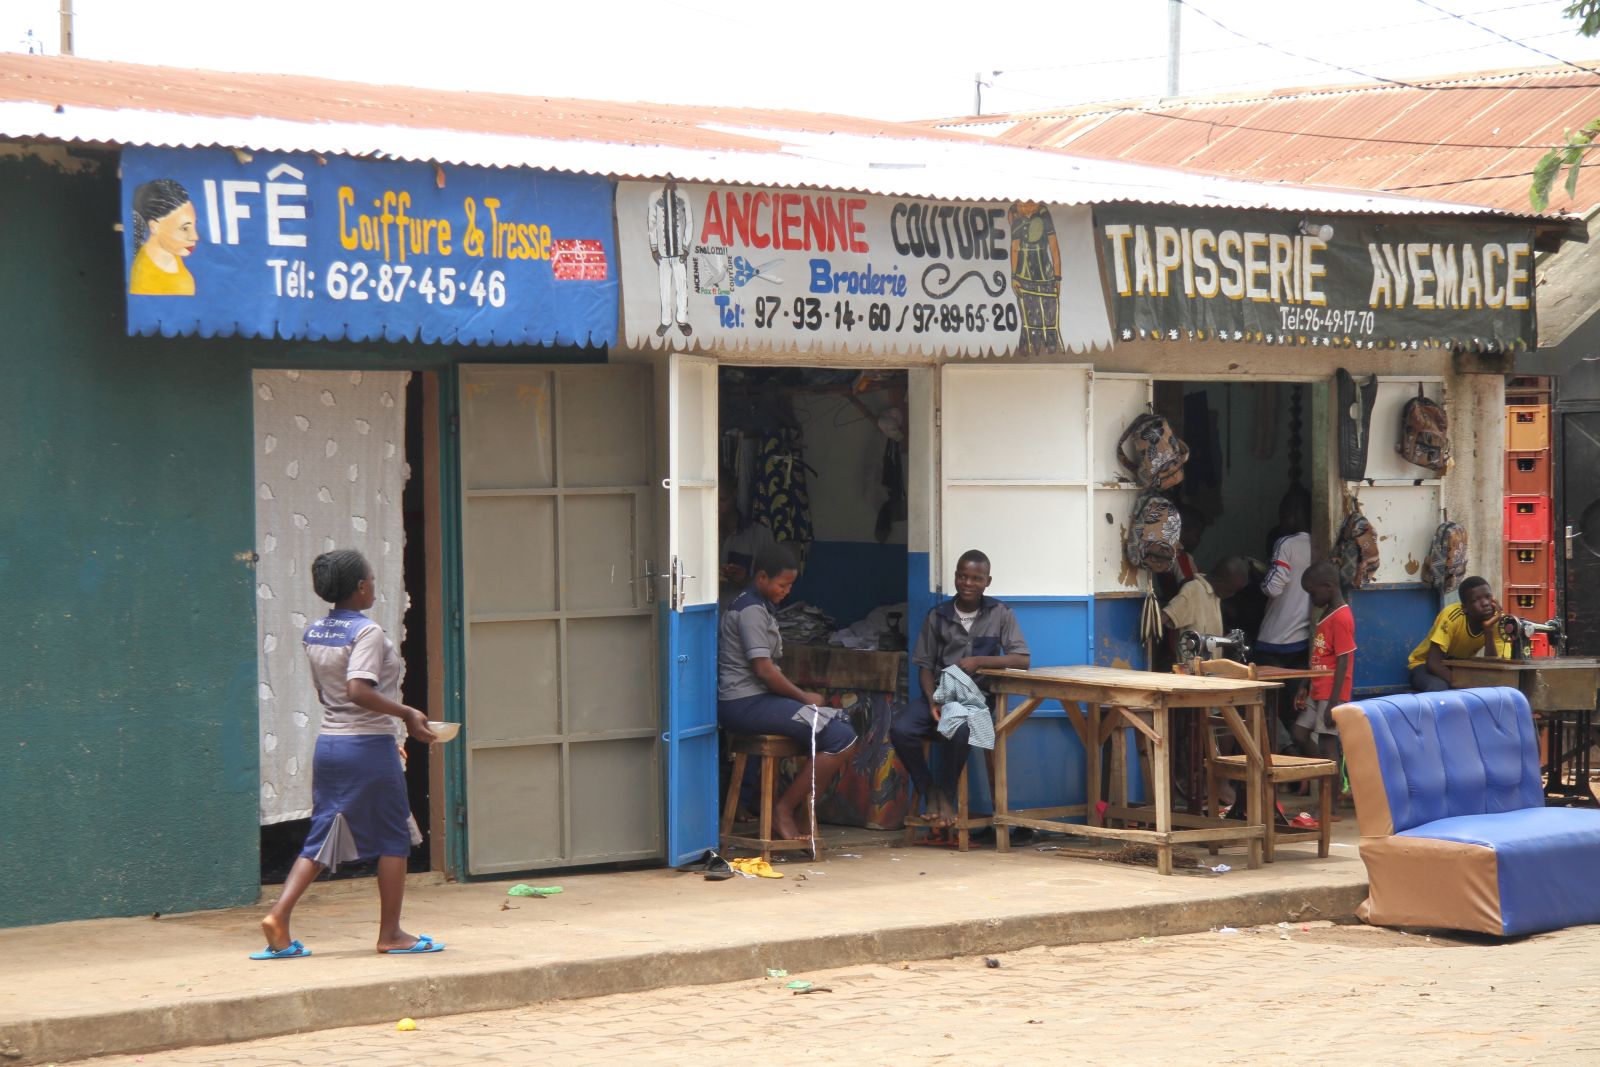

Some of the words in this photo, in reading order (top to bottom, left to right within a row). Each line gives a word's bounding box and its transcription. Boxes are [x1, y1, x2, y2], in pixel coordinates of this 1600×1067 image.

[203, 163, 308, 247] IFÊ
[338, 186, 453, 263] Coiffure
[463, 196, 485, 258] &
[483, 197, 552, 260] Tresse
[700, 190, 869, 253] ANCIENNE
[890, 202, 1009, 260] COUTURE
[266, 259, 315, 299] Tél:
[692, 257, 701, 294] ANCIENNE
[727, 255, 735, 293] COUTURE
[809, 258, 907, 298] Broderie
[1105, 224, 1329, 306] TAPISSERIE
[1368, 243, 1531, 310] AVEMACE
[714, 295, 746, 329] Tel:
